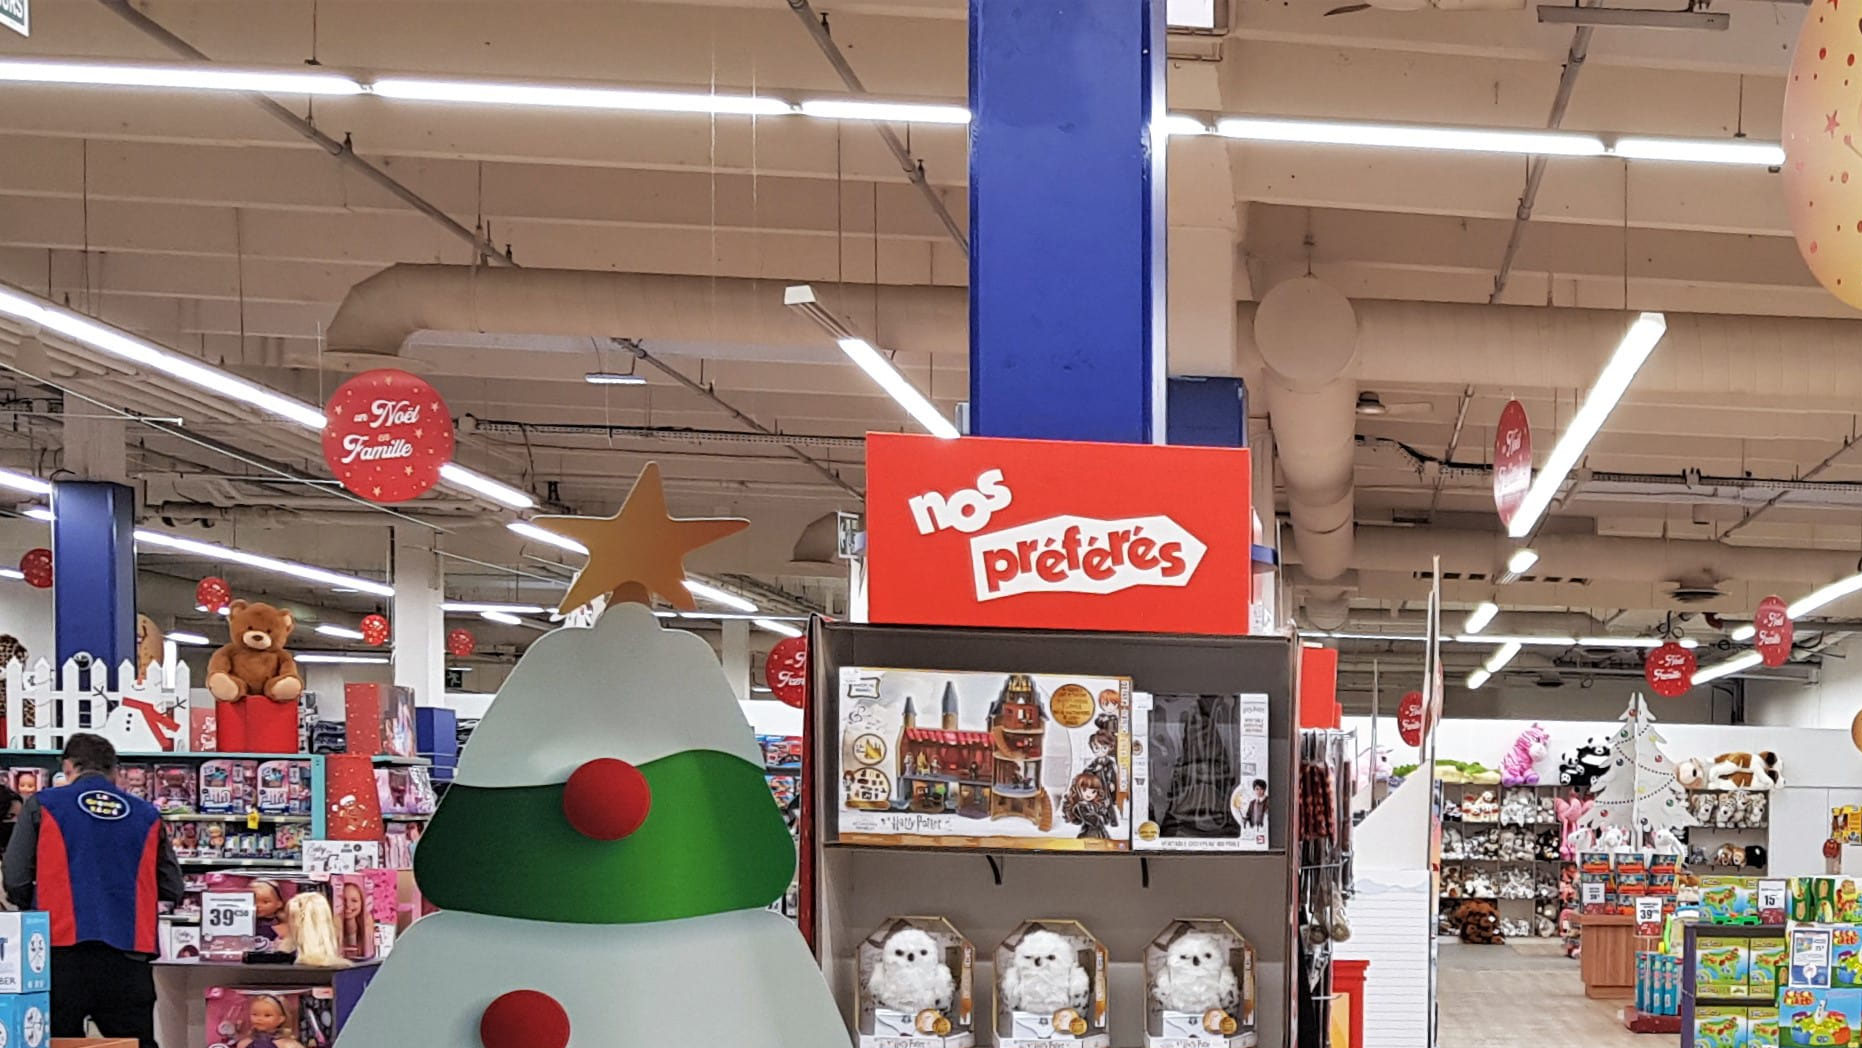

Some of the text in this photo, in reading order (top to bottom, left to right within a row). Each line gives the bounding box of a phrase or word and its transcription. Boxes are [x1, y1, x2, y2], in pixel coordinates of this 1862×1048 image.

[369, 399, 421, 429] Noël
[341, 434, 413, 464] Famille
[908, 468, 1013, 535] nos
[983, 524, 1187, 593] préférés
[891, 815, 915, 831] Harry
[916, 815, 942, 832] Potter
